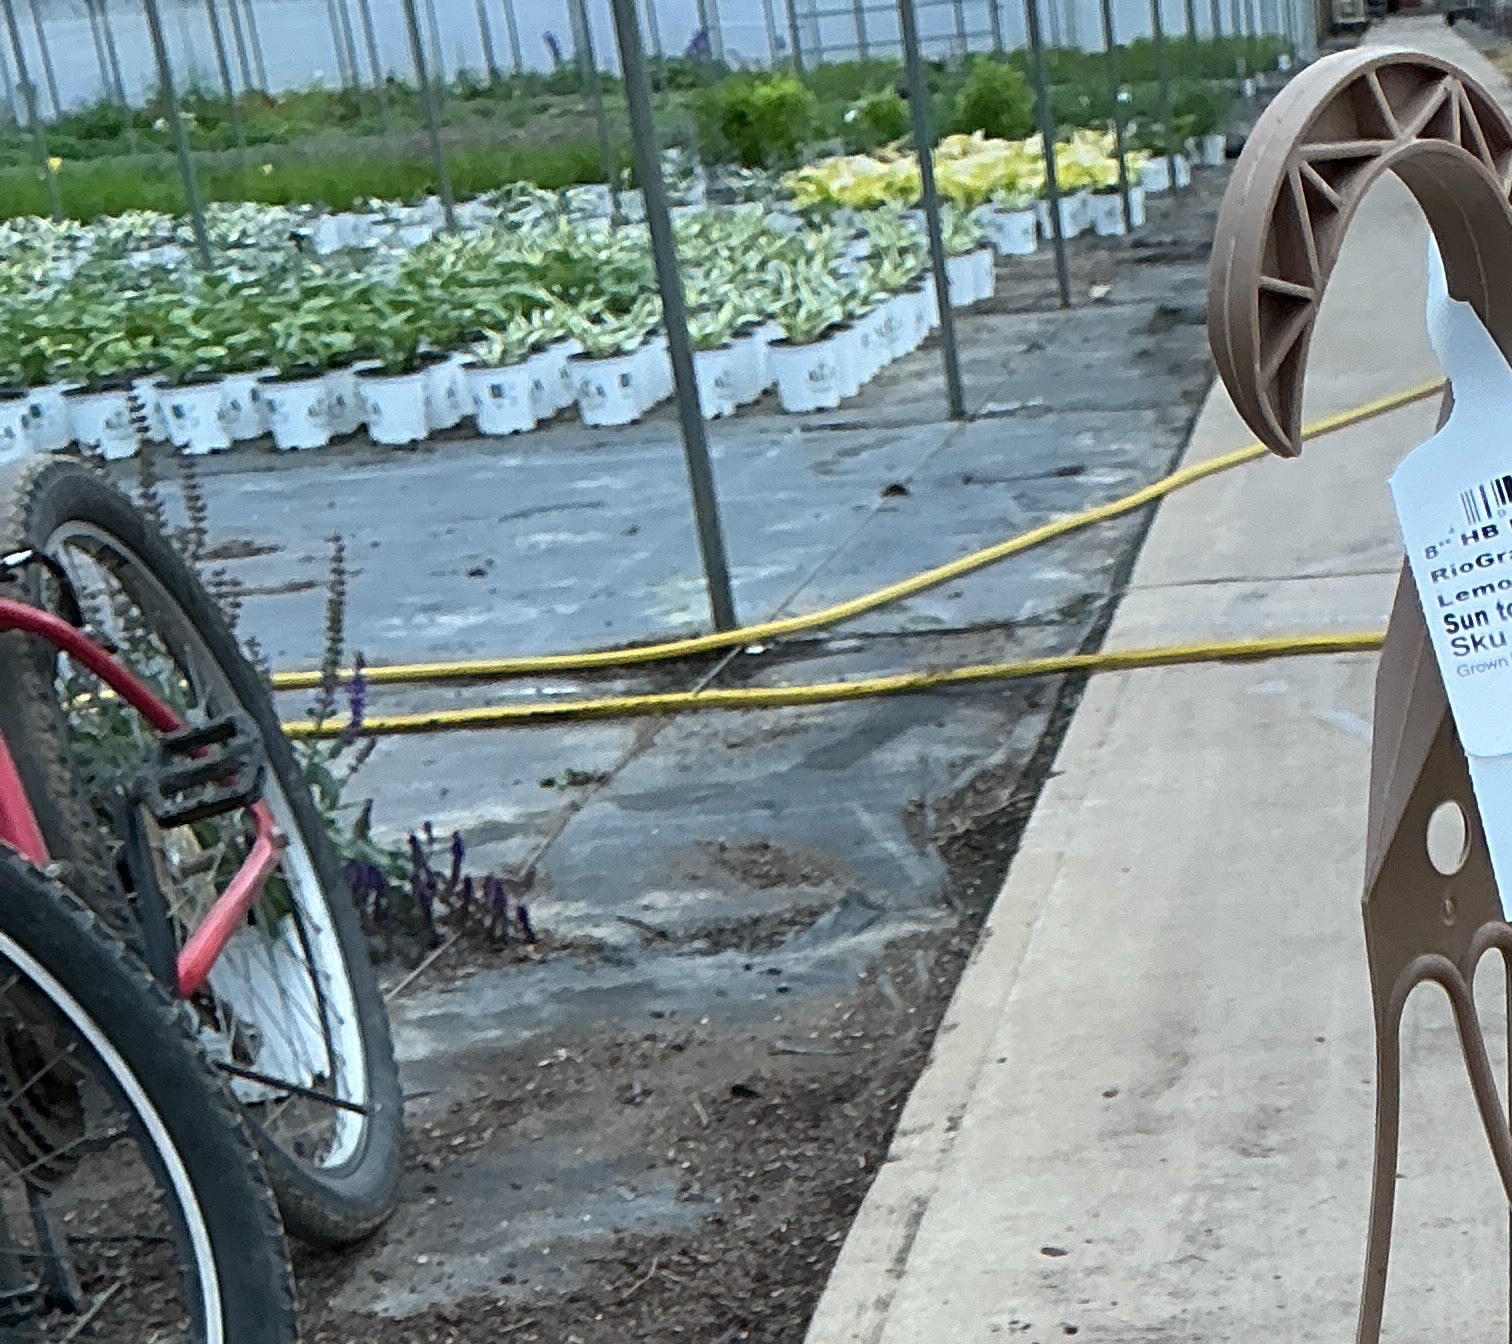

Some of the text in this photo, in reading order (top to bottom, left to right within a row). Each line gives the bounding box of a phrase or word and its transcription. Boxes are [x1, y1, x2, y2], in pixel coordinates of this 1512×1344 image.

[1460, 523, 1499, 547] HB
[1443, 608, 1489, 634] Sun
[1456, 658, 1508, 678] Grown
